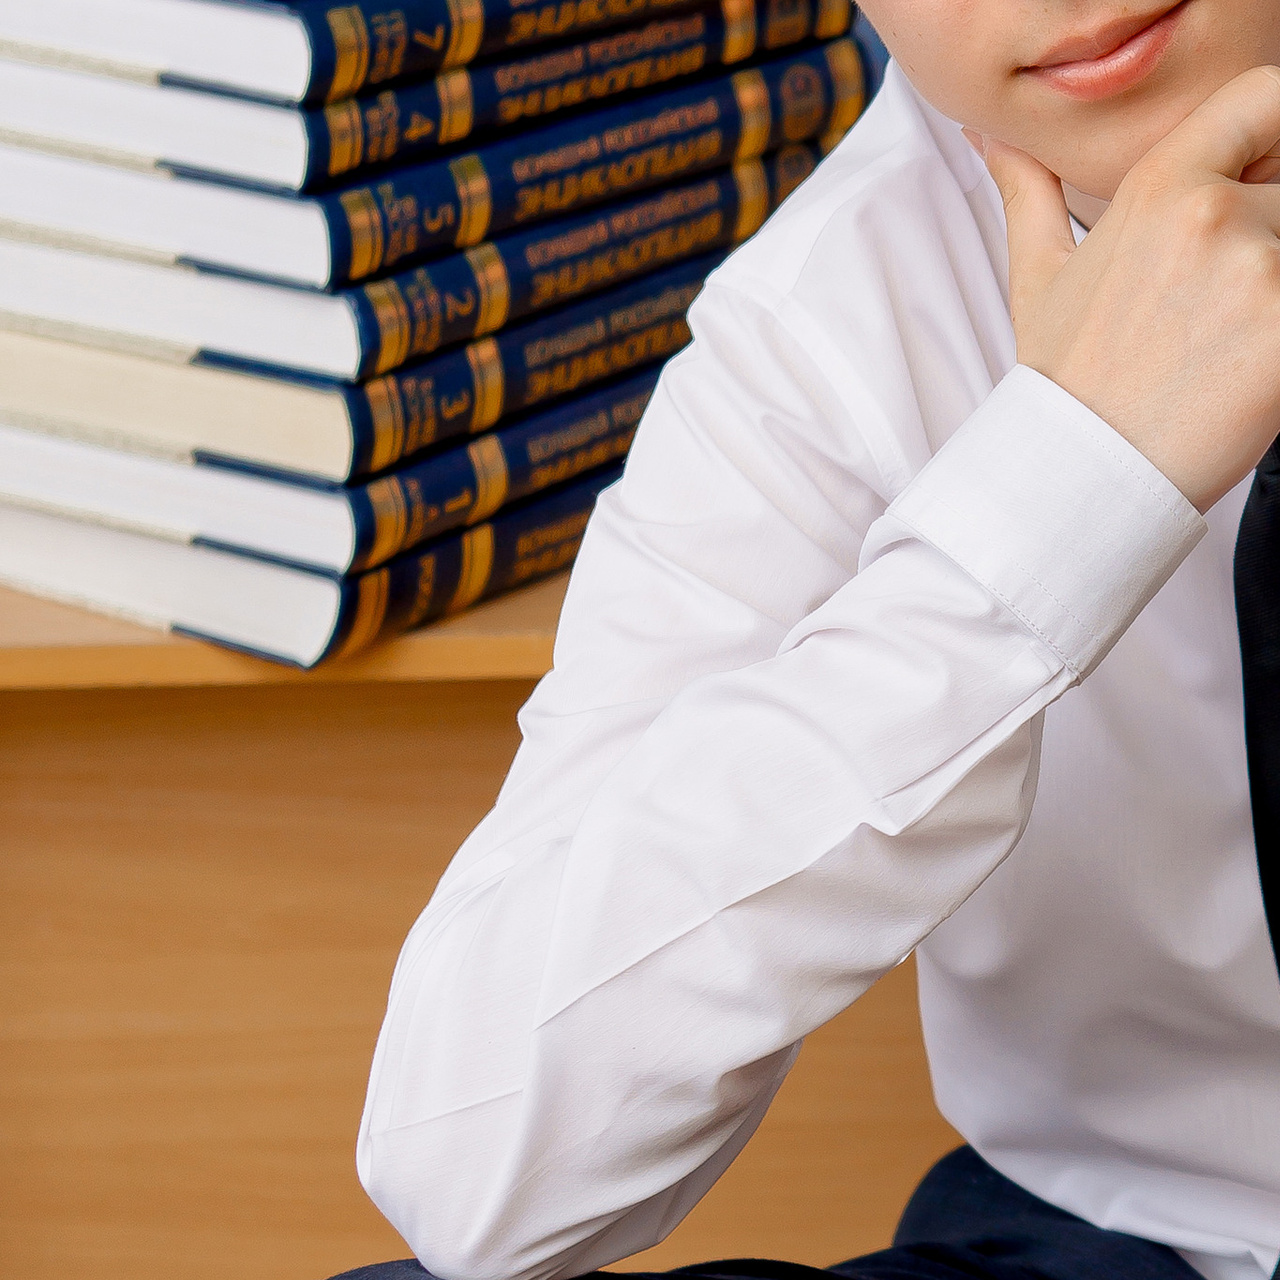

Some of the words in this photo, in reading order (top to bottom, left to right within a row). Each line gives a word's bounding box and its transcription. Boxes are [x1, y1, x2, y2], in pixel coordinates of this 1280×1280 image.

[412, 23, 445, 52] 7
[404, 110, 435, 143] 4
[423, 202, 455, 234] 5
[445, 287, 477, 321] 2
[440, 388, 472, 421] 3
